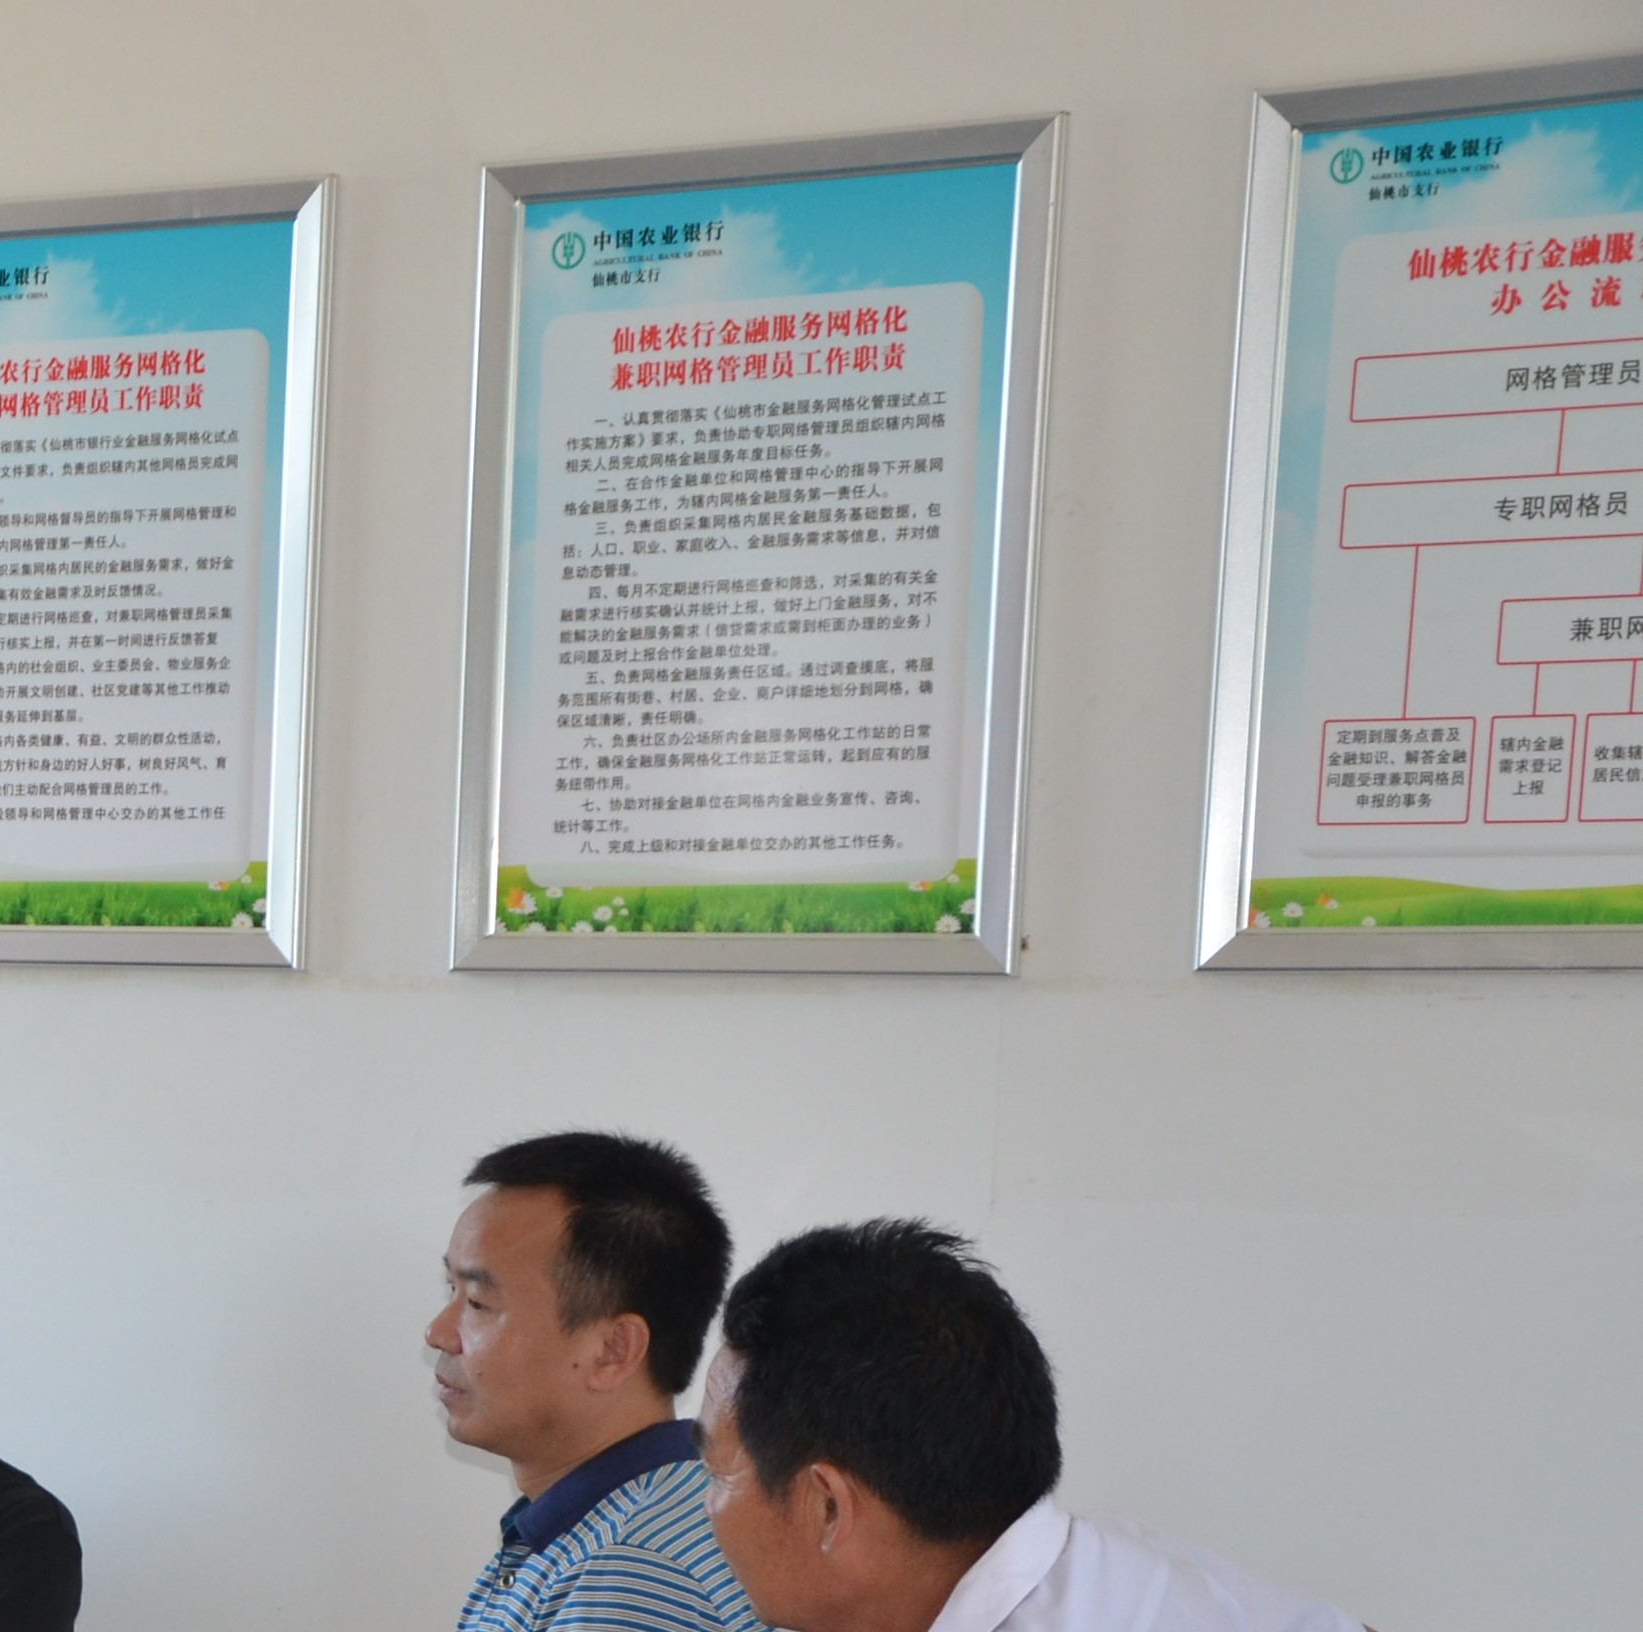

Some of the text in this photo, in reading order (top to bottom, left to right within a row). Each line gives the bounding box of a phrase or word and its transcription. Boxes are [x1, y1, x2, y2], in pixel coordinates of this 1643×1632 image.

[1371, 135, 1504, 167] 中国农业银行
[1368, 181, 1440, 202] 仙桃市支行
[593, 220, 725, 252] 中国农业银行
[1407, 231, 1643, 280] 仙桃农行金融服
[592, 267, 661, 288] 仙桃市支行
[1490, 275, 1643, 316] 办公流
[611, 305, 908, 355] 仙桃农行金融服务网格化
[610, 343, 907, 391] 兼职网格管理员工作职责
[1505, 358, 1641, 392] 网格管理员
[1493, 491, 1629, 522] 专职网格员
[1336, 727, 1461, 745] 定期到服务点普及
[1500, 735, 1564, 753] 辖内金融
[1327, 747, 1467, 766] 金融知识、解答金融
[1499, 758, 1562, 774] 需求登记
[1326, 770, 1465, 788] 问题受理兼职网格员
[1592, 767, 1643, 783] 居民信
[1513, 779, 1544, 796] 上报
[1355, 792, 1432, 808] 申报的事务
